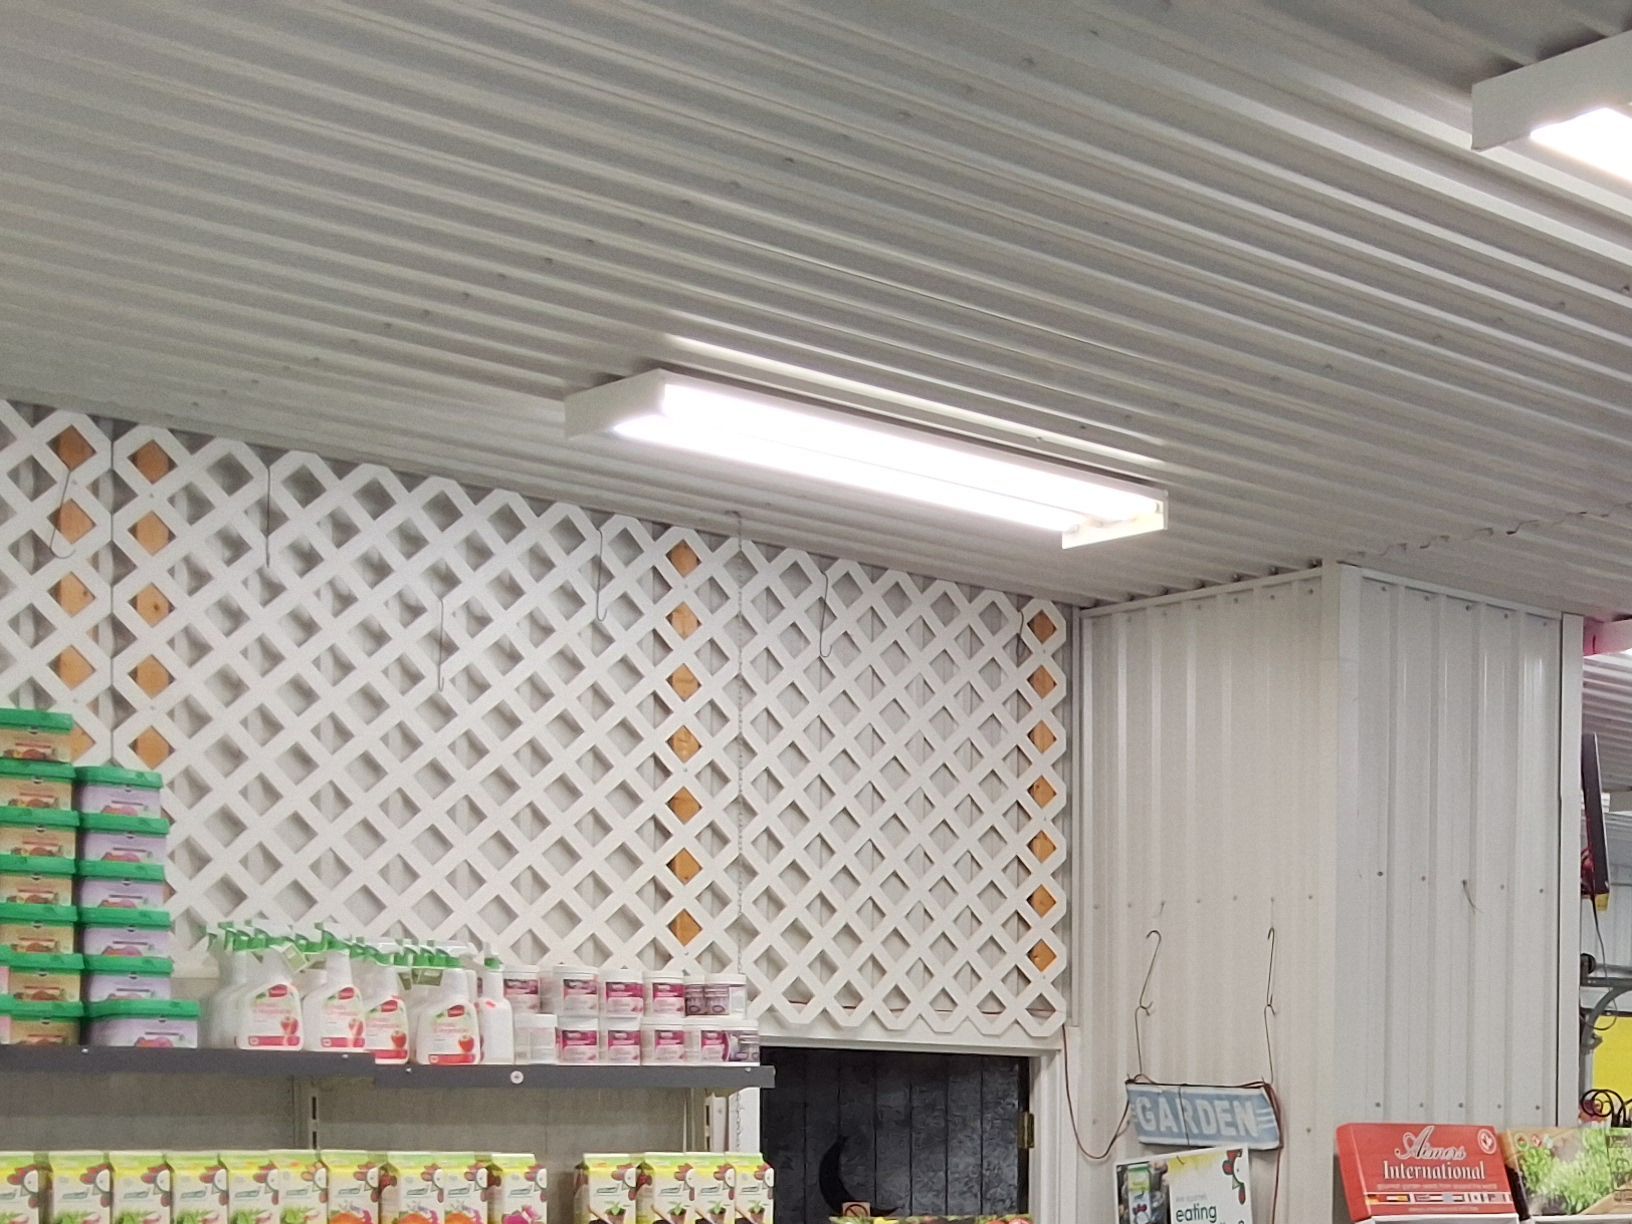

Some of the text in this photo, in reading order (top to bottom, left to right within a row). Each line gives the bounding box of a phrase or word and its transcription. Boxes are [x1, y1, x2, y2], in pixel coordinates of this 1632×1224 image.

[1135, 1095, 1260, 1138] GARDEN
[1383, 1160, 1486, 1180] International
[1175, 1203, 1218, 1224] eating
